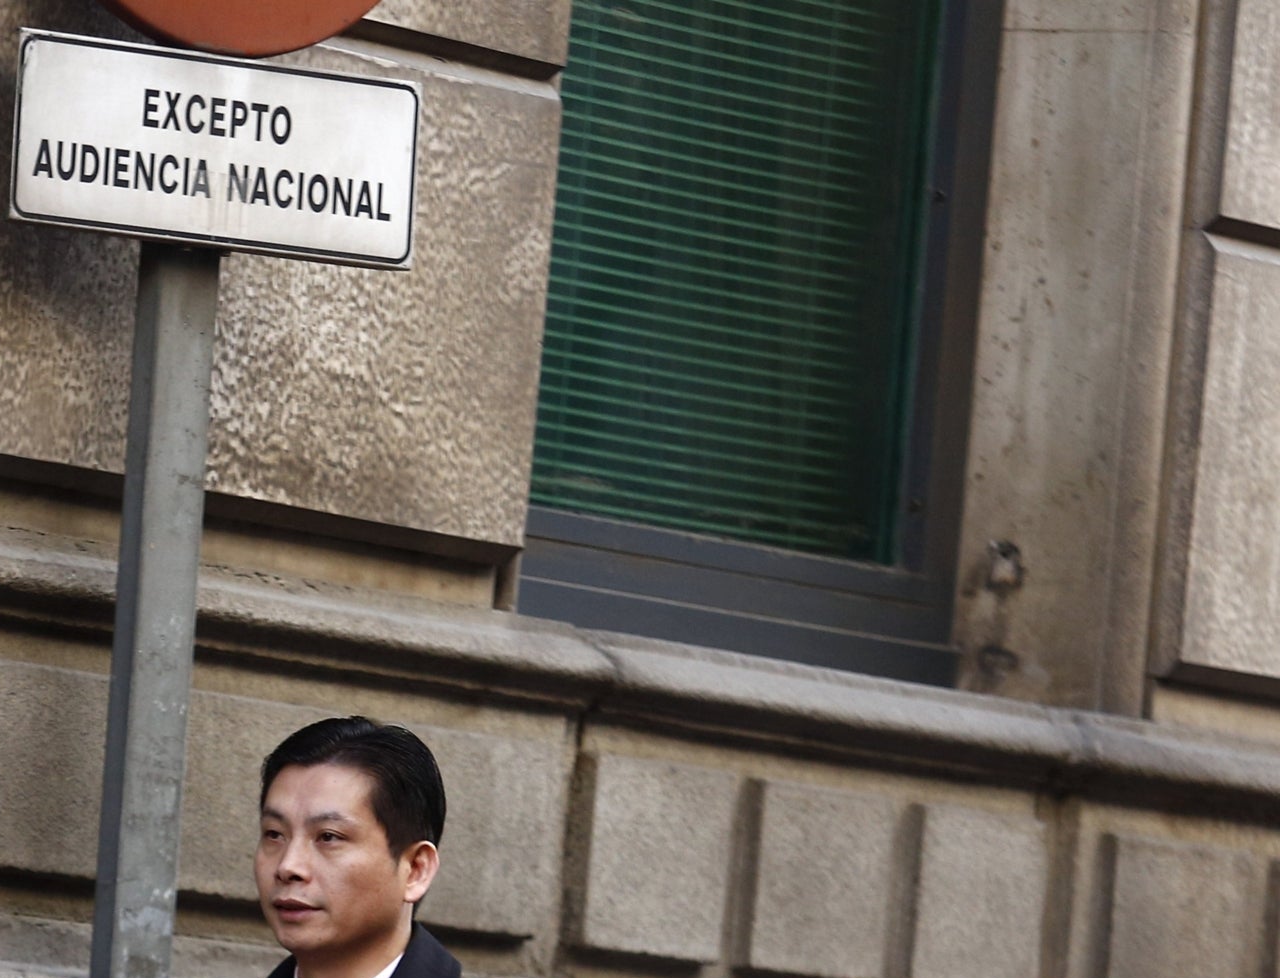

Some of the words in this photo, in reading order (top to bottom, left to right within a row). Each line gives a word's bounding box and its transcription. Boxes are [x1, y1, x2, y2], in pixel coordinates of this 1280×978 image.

[142, 89, 292, 145] EXCEPTO
[32, 138, 212, 199] AUDIENCIA
[226, 163, 392, 222] NACIONAL
